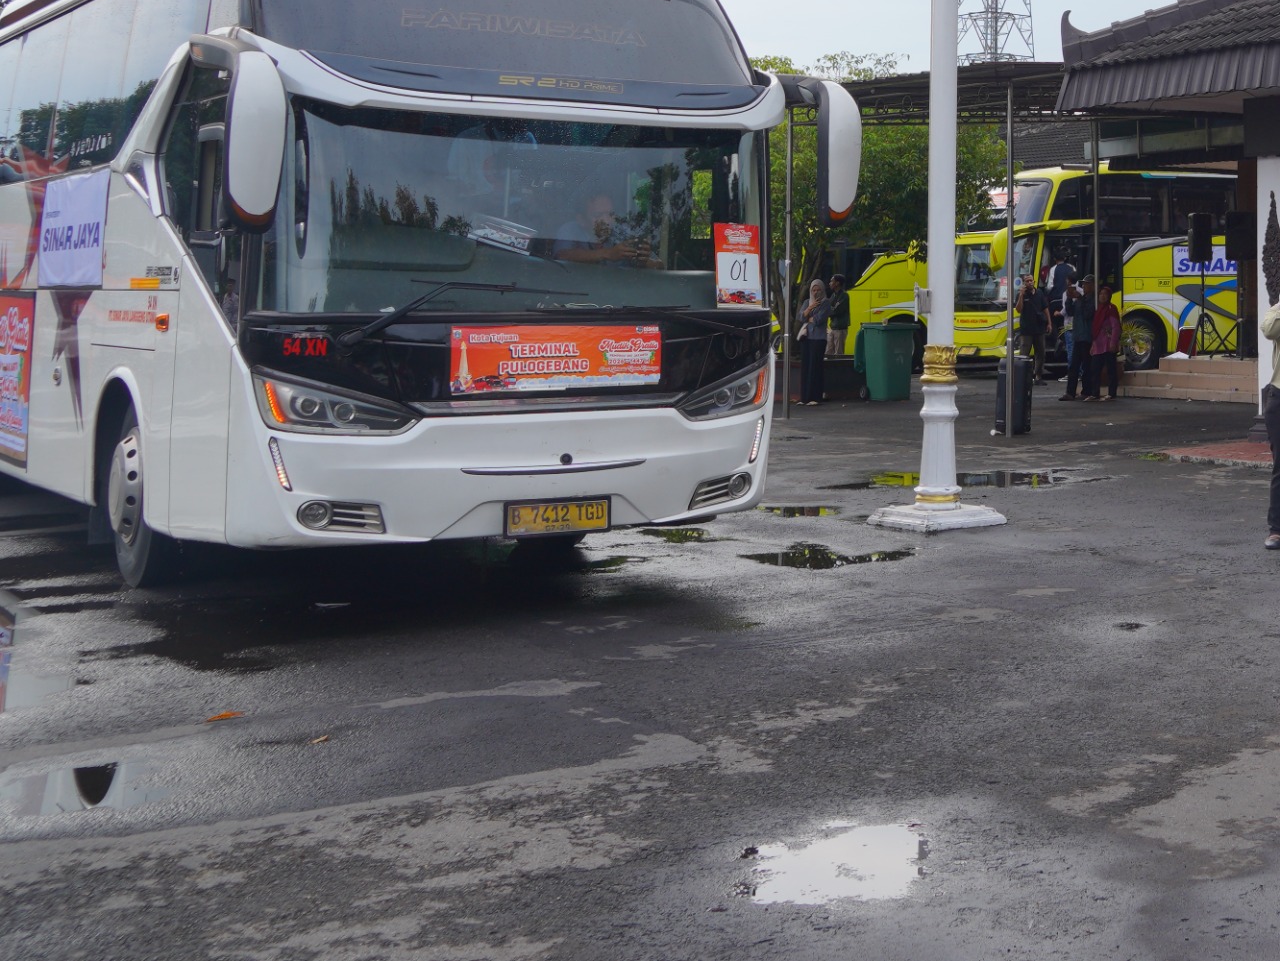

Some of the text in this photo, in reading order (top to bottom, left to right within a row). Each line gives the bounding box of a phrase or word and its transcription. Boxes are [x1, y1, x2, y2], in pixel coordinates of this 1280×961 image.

[401, 8, 647, 47] PARIWISATA
[537, 78, 556, 88] 2
[559, 80, 580, 89] HD
[583, 82, 619, 92] PRIME
[43, 221, 100, 252] SINAR JAYA
[730, 258, 748, 282] 01
[283, 338, 328, 357] 54 XN
[470, 334, 519, 344] Kota Tujuan
[599, 338, 659, 352] Mudik Gratis
[511, 343, 579, 357] TERMINAL
[499, 359, 589, 374] PULOGEBANG
[512, 503, 605, 525] B 7412 TGD
